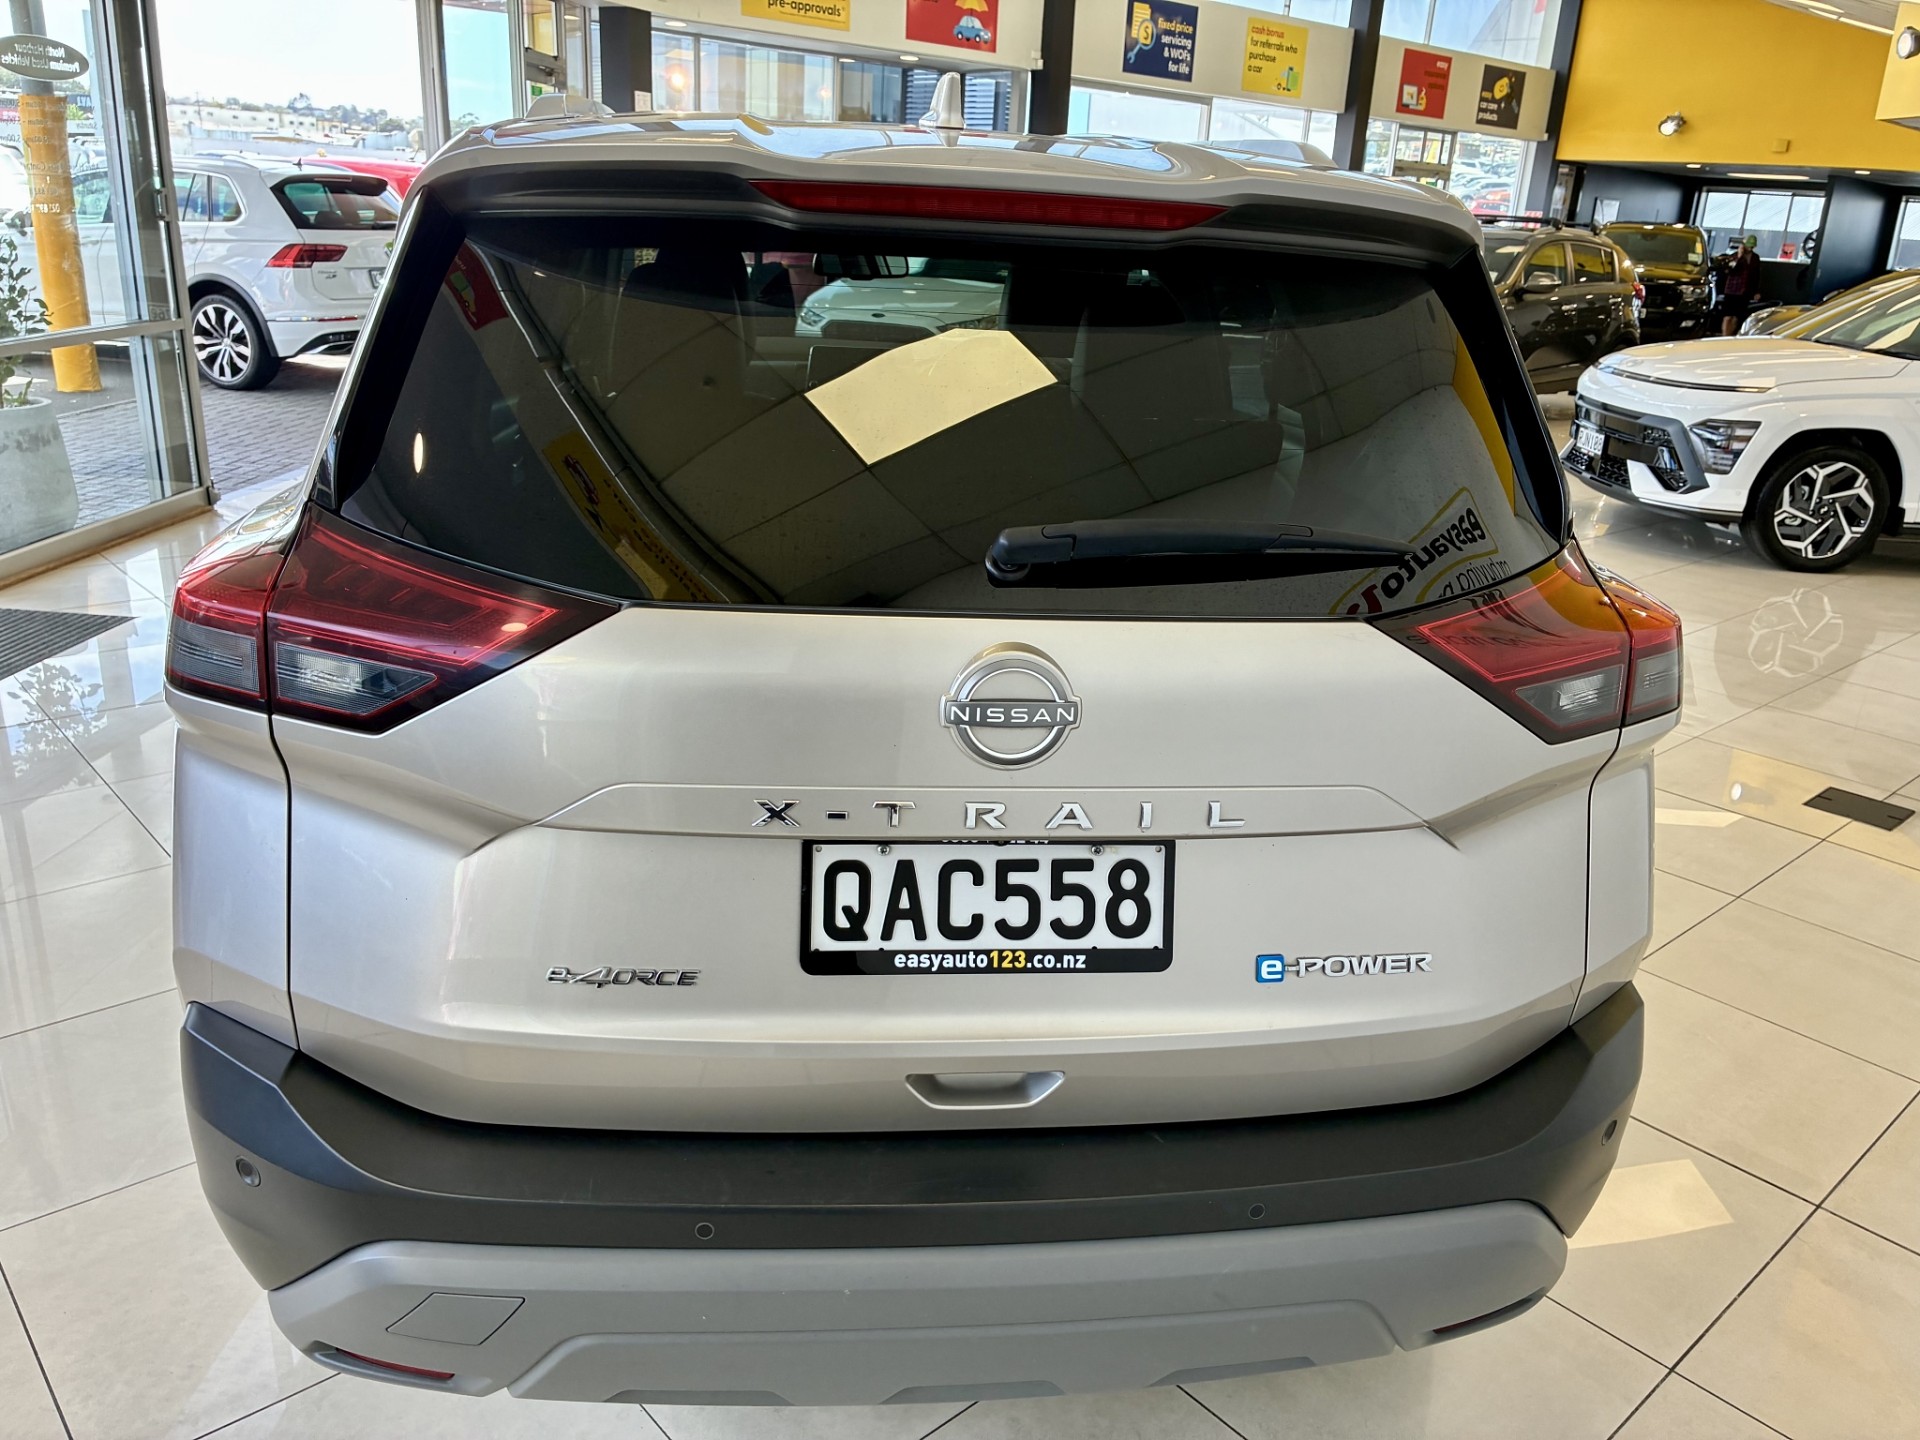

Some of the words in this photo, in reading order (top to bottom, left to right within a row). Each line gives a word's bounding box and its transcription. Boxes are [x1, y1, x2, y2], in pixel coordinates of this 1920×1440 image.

[1157, 17, 1175, 31] fixed
[1176, 22, 1193, 34] price
[1251, 25, 1265, 35] cash
[1266, 27, 1285, 38] bonus
[1161, 35, 1192, 50] servicing
[1250, 36, 1259, 46] for
[1259, 39, 1284, 52] referrals
[1285, 43, 1298, 54] who
[1163, 47, 1170, 58] &
[1170, 47, 1191, 61] WOFs
[1248, 51, 1276, 63] purchase
[1168, 60, 1178, 72] for
[1179, 62, 1190, 74] life
[1253, 65, 1263, 73] car
[1478, 112, 1498, 121] products
[949, 705, 1076, 724] NISSAN
[751, 799, 1247, 829] X-TRAIL
[822, 858, 1153, 943] QAC558
[894, 950, 1087, 972] easyauto123.co.nz
[1257, 953, 1433, 981] e-POWER
